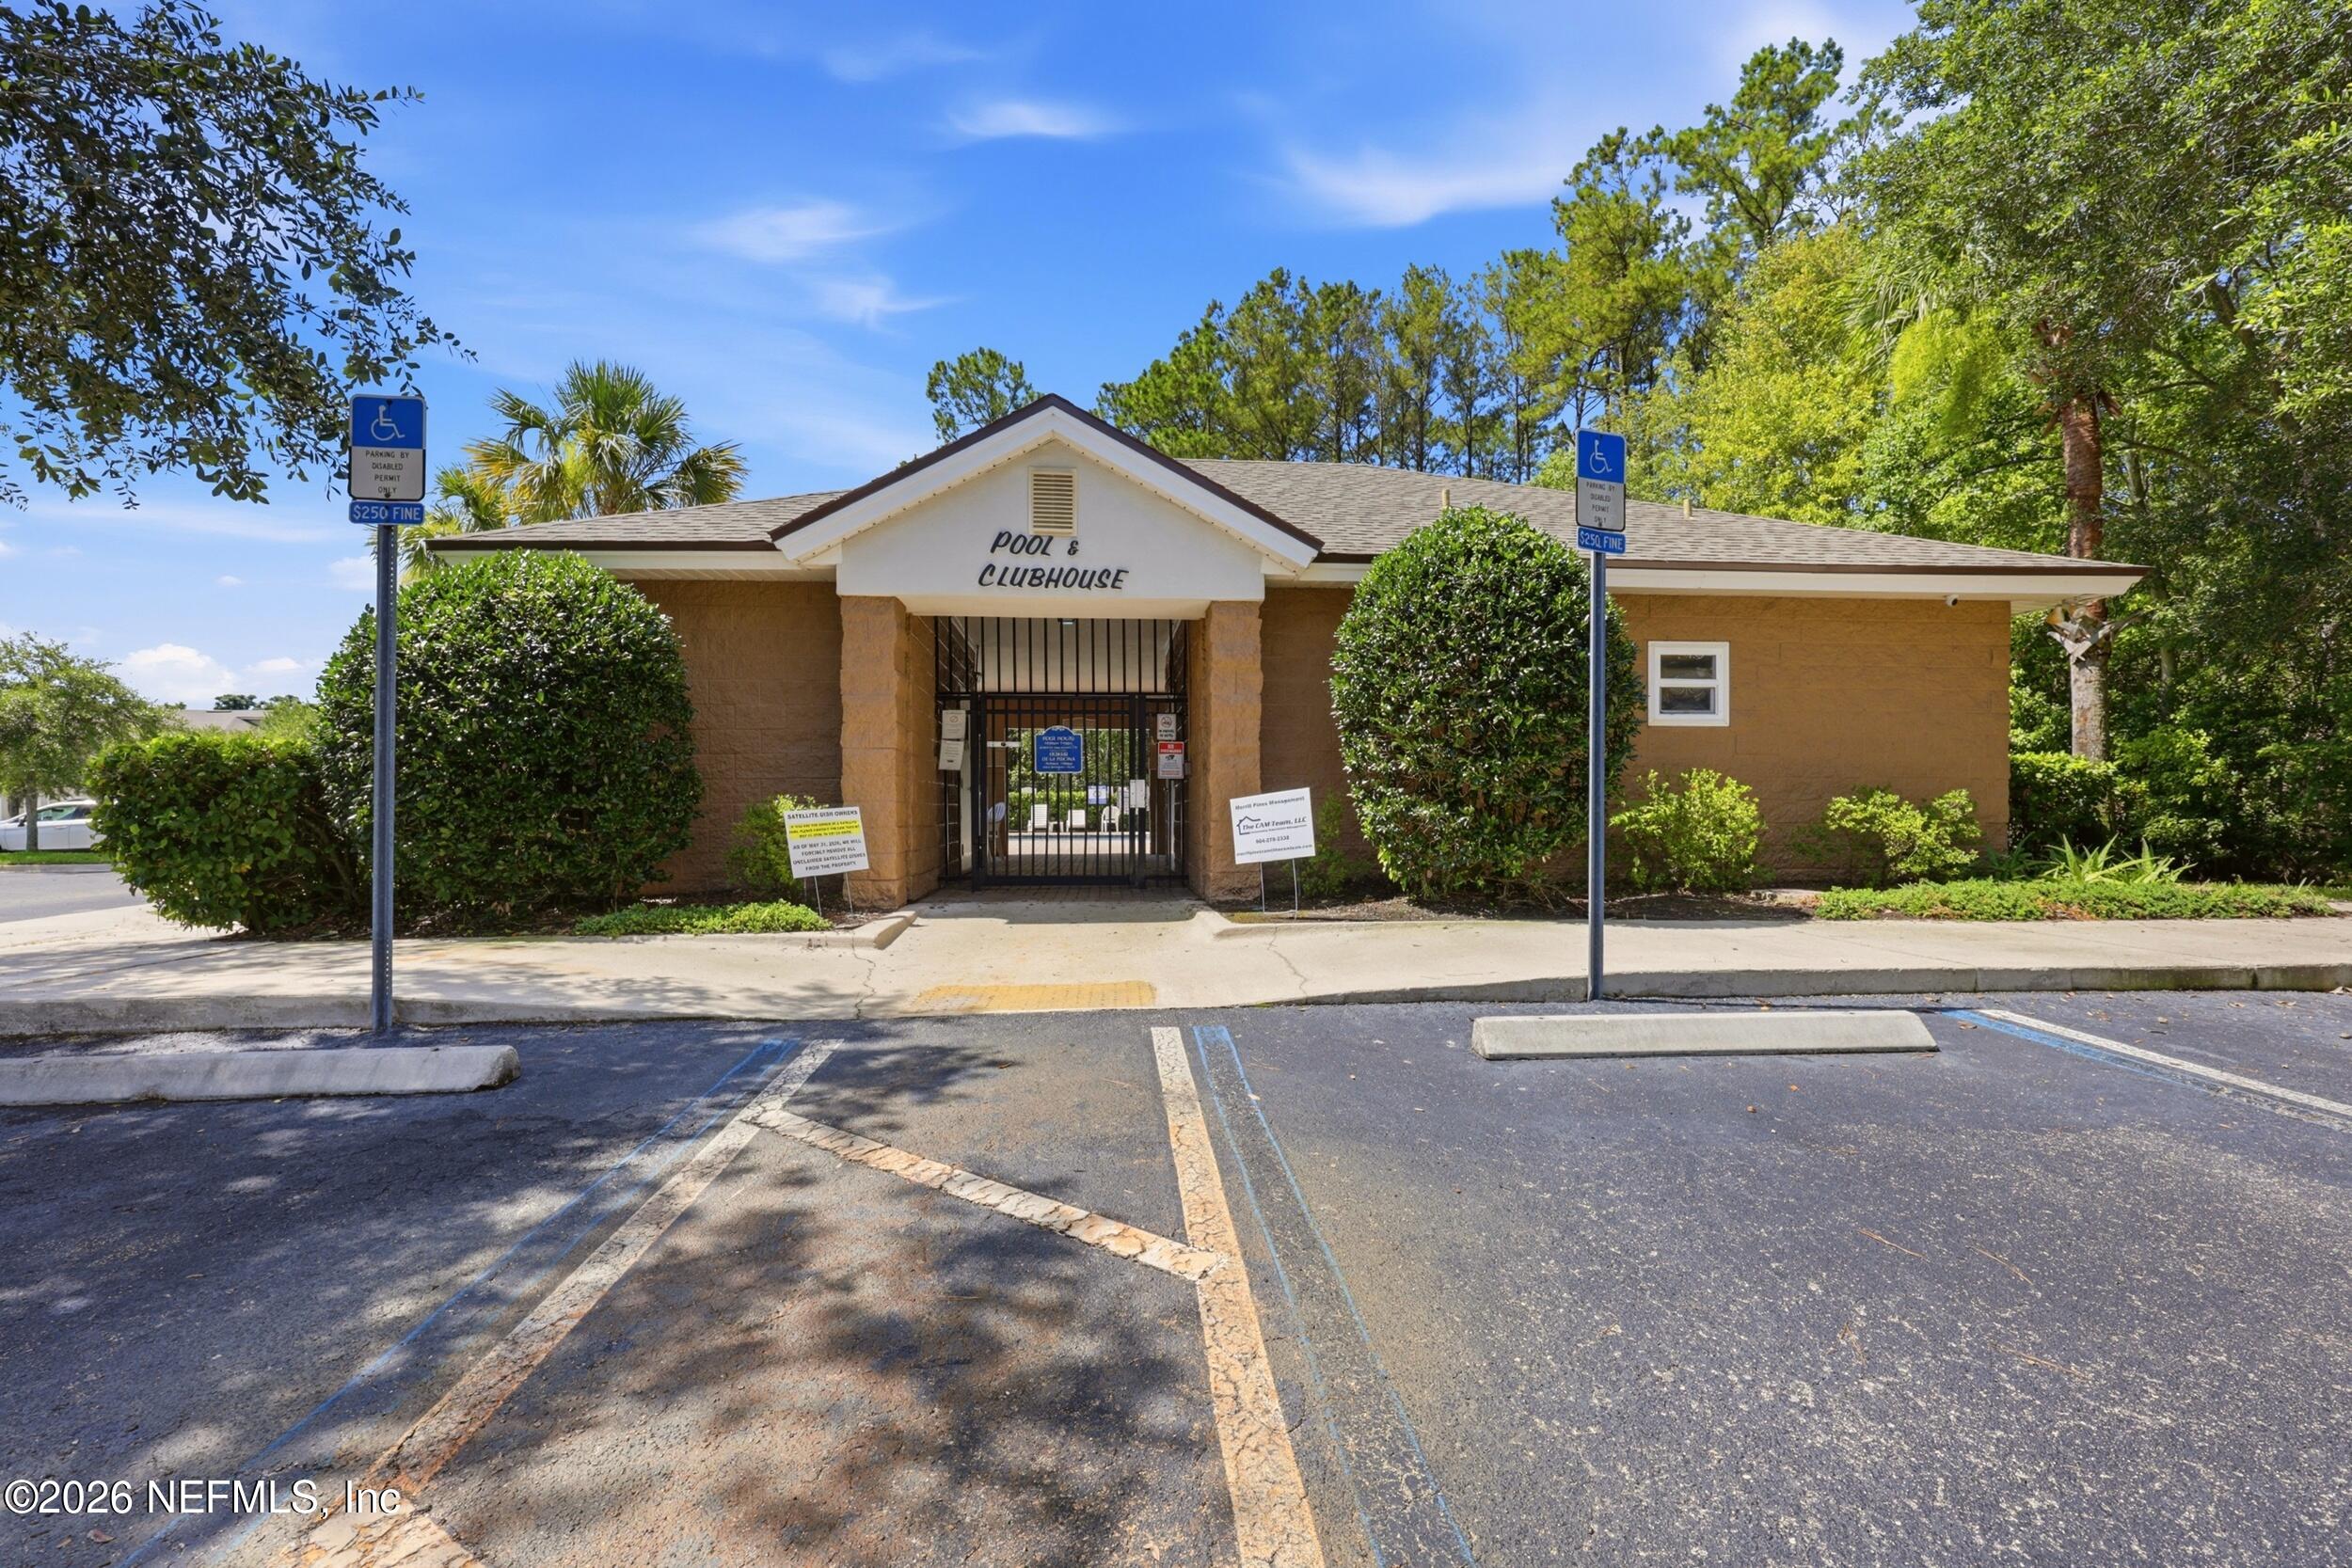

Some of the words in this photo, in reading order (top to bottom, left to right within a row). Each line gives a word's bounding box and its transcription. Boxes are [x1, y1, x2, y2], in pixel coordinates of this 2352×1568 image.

[365, 450, 395, 458] PARKING
[400, 451, 410, 459] BY
[372, 462, 404, 470] DISABLED
[1585, 481, 1606, 490] PARKING
[353, 504, 388, 519] $250
[393, 506, 421, 521] FINE
[990, 531, 1054, 556] POOL
[1067, 539, 1079, 556] &
[1580, 531, 1600, 547] $250
[1603, 535, 1623, 550] FINE
[977, 563, 1130, 591] CLUBHOUSE
[1294, 816, 1308, 824] LLC
